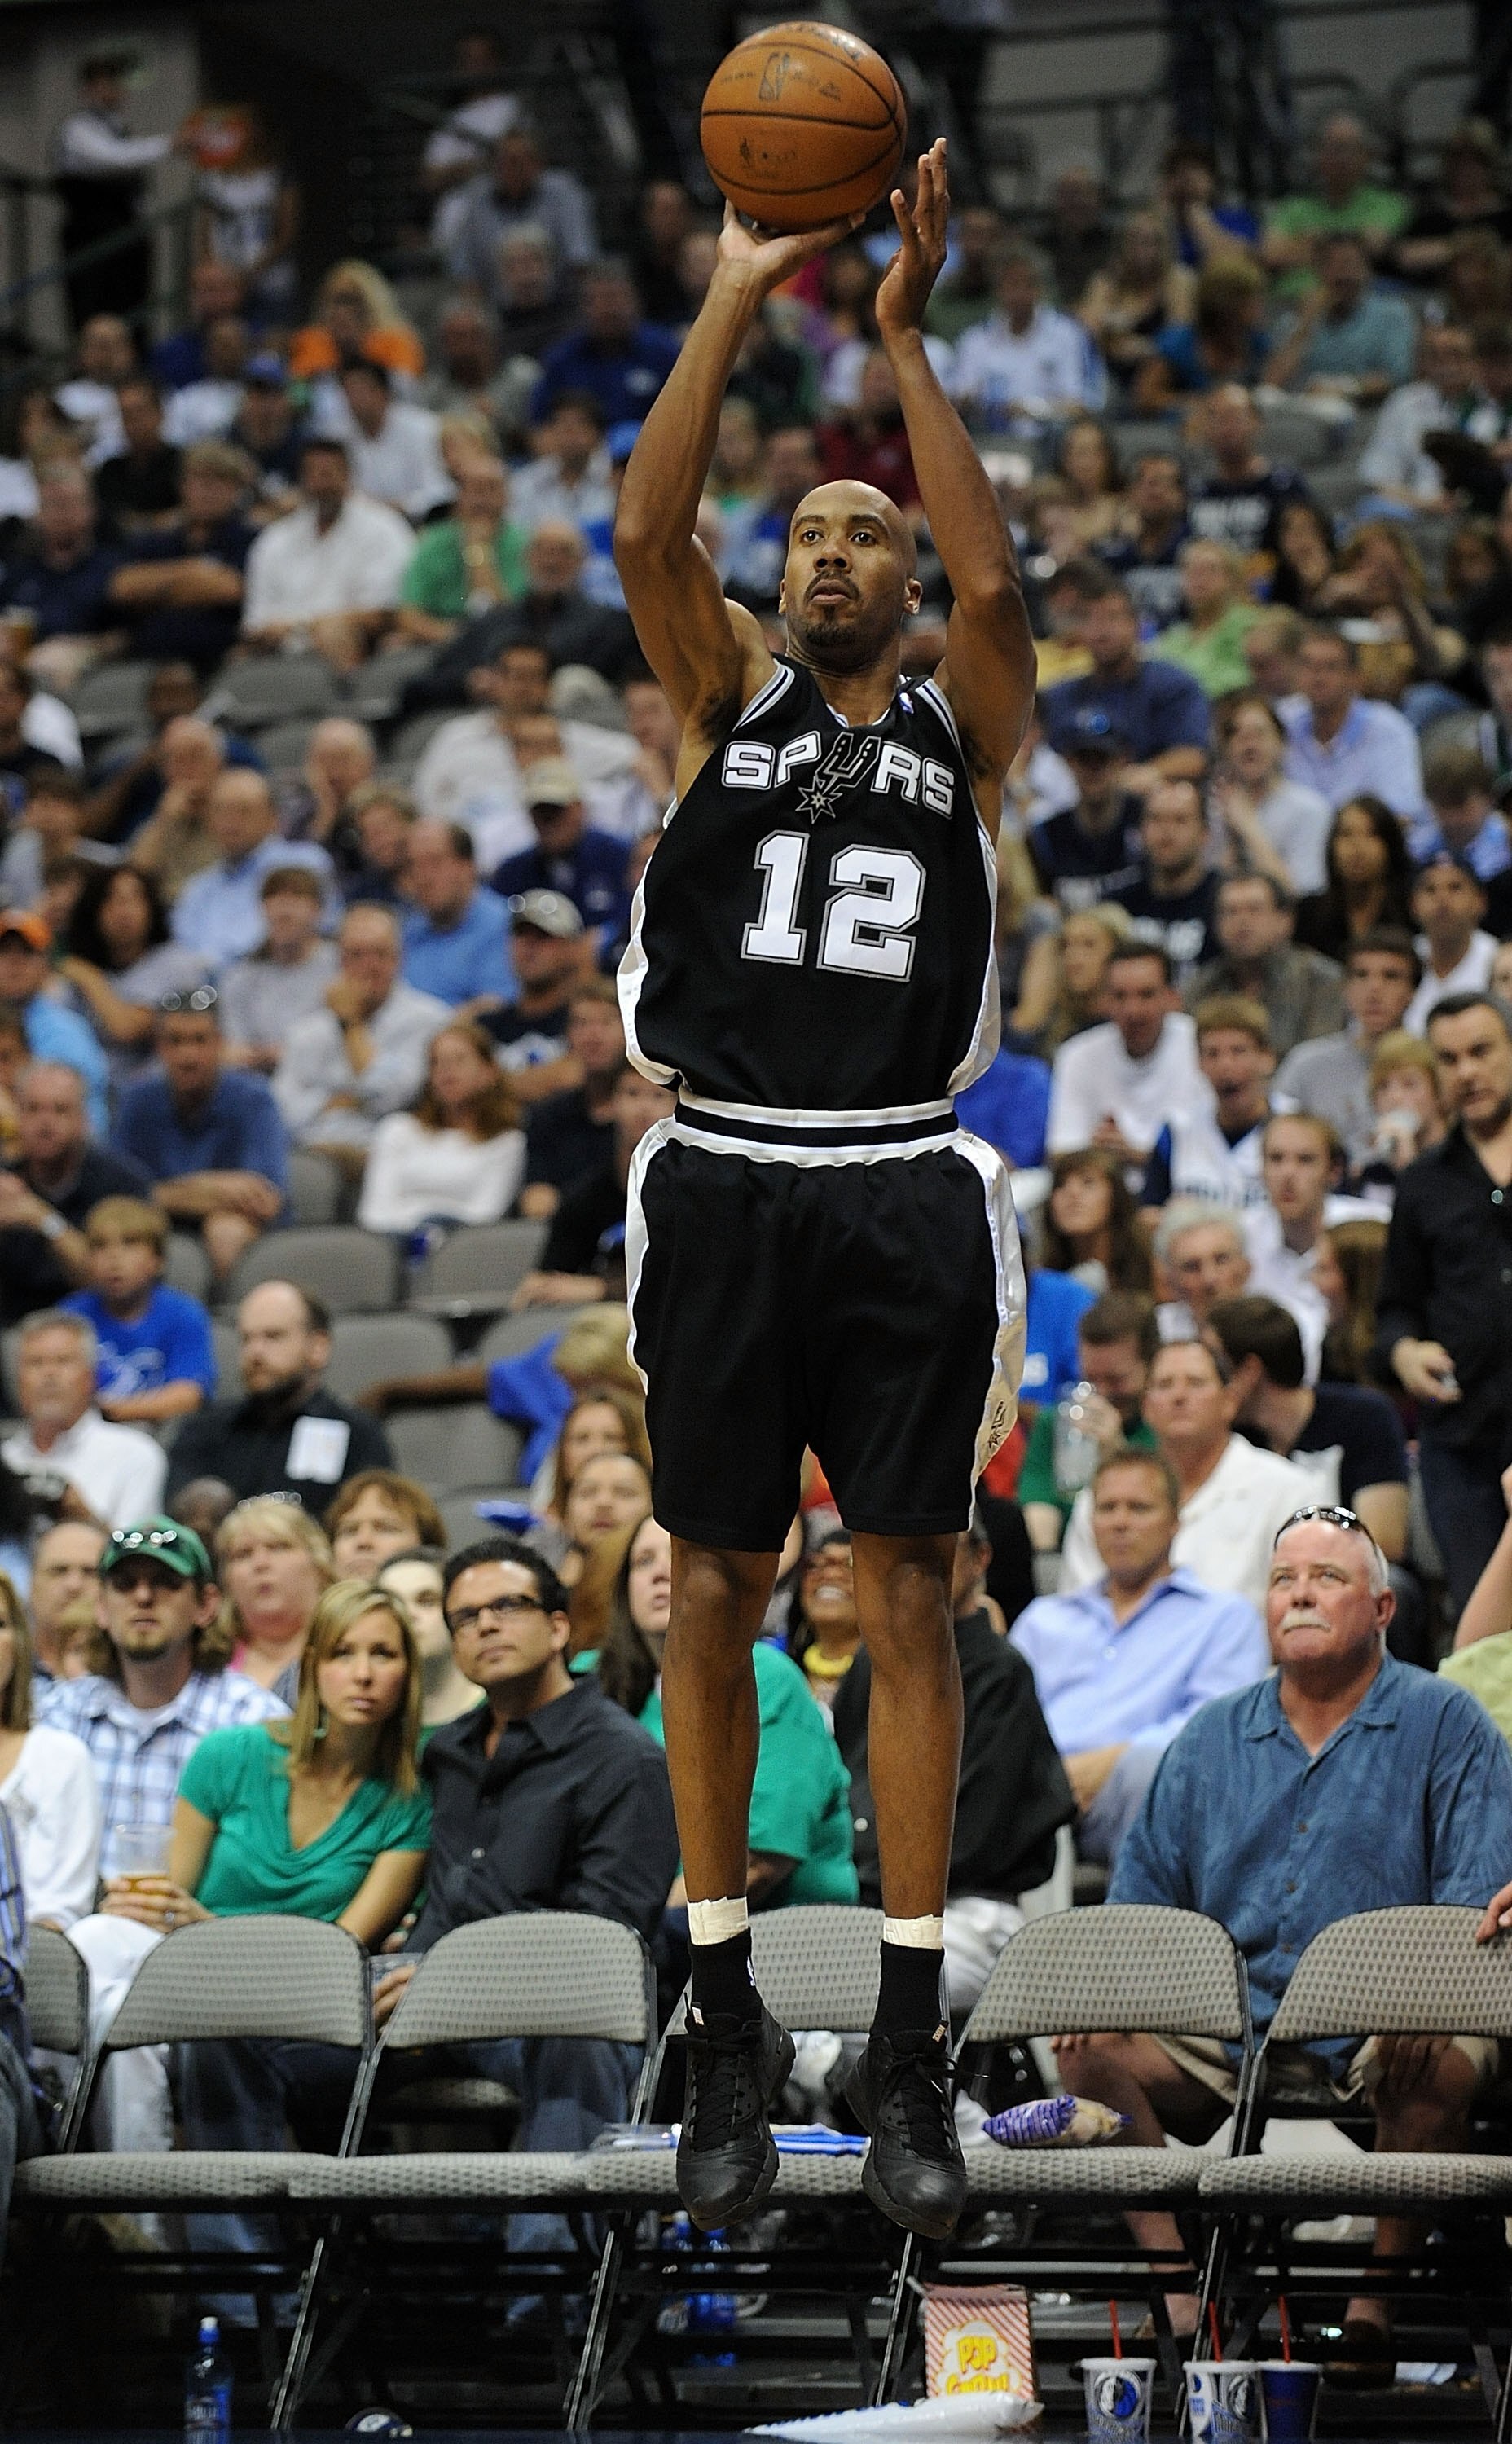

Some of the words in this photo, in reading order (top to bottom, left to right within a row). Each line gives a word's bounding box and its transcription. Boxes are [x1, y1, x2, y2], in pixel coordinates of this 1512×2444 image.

[722, 731, 956, 821] SPURS
[741, 829, 927, 983] 12
[958, 2336, 997, 2374] POP
